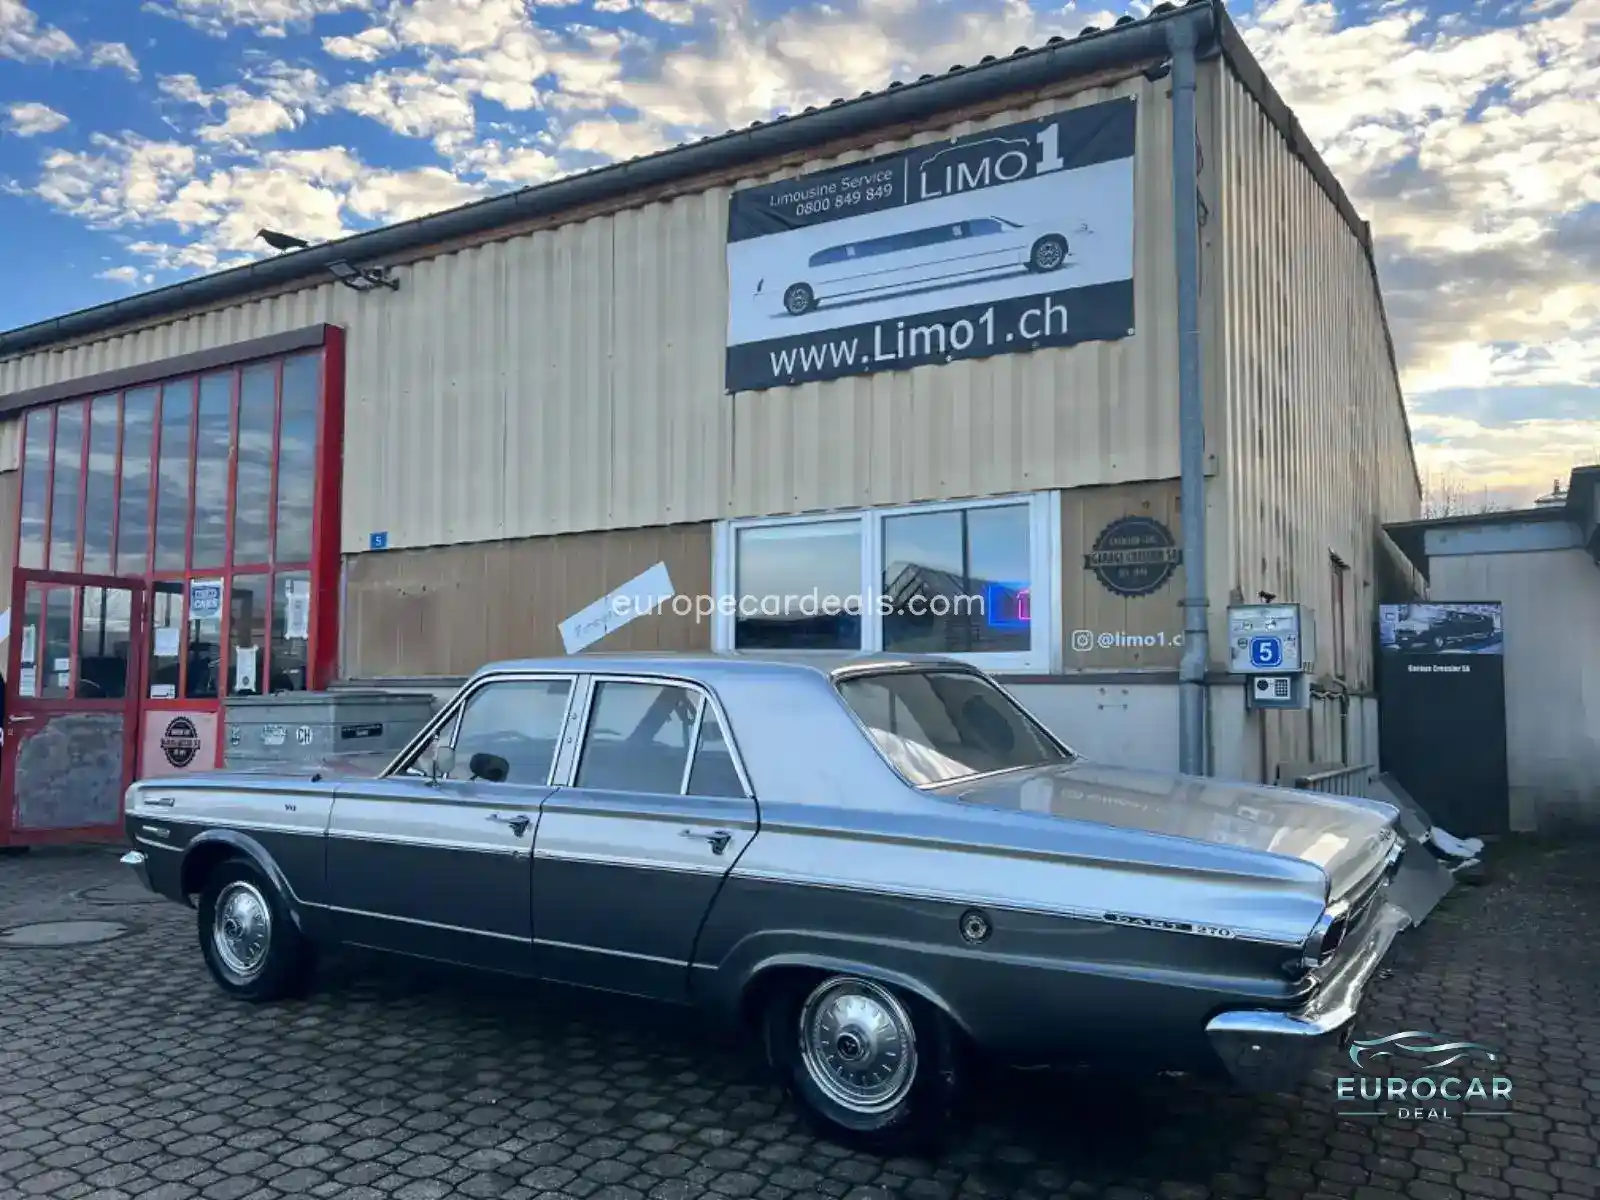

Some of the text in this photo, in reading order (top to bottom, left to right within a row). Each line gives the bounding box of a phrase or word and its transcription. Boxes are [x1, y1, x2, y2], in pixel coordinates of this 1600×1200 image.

[770, 168, 893, 207] Limousine Service
[796, 182, 893, 217] 0800 849 849
[769, 297, 1069, 377] www.Limo1.ch
[1259, 641, 1273, 662] 5
[297, 727, 312, 744] CH
